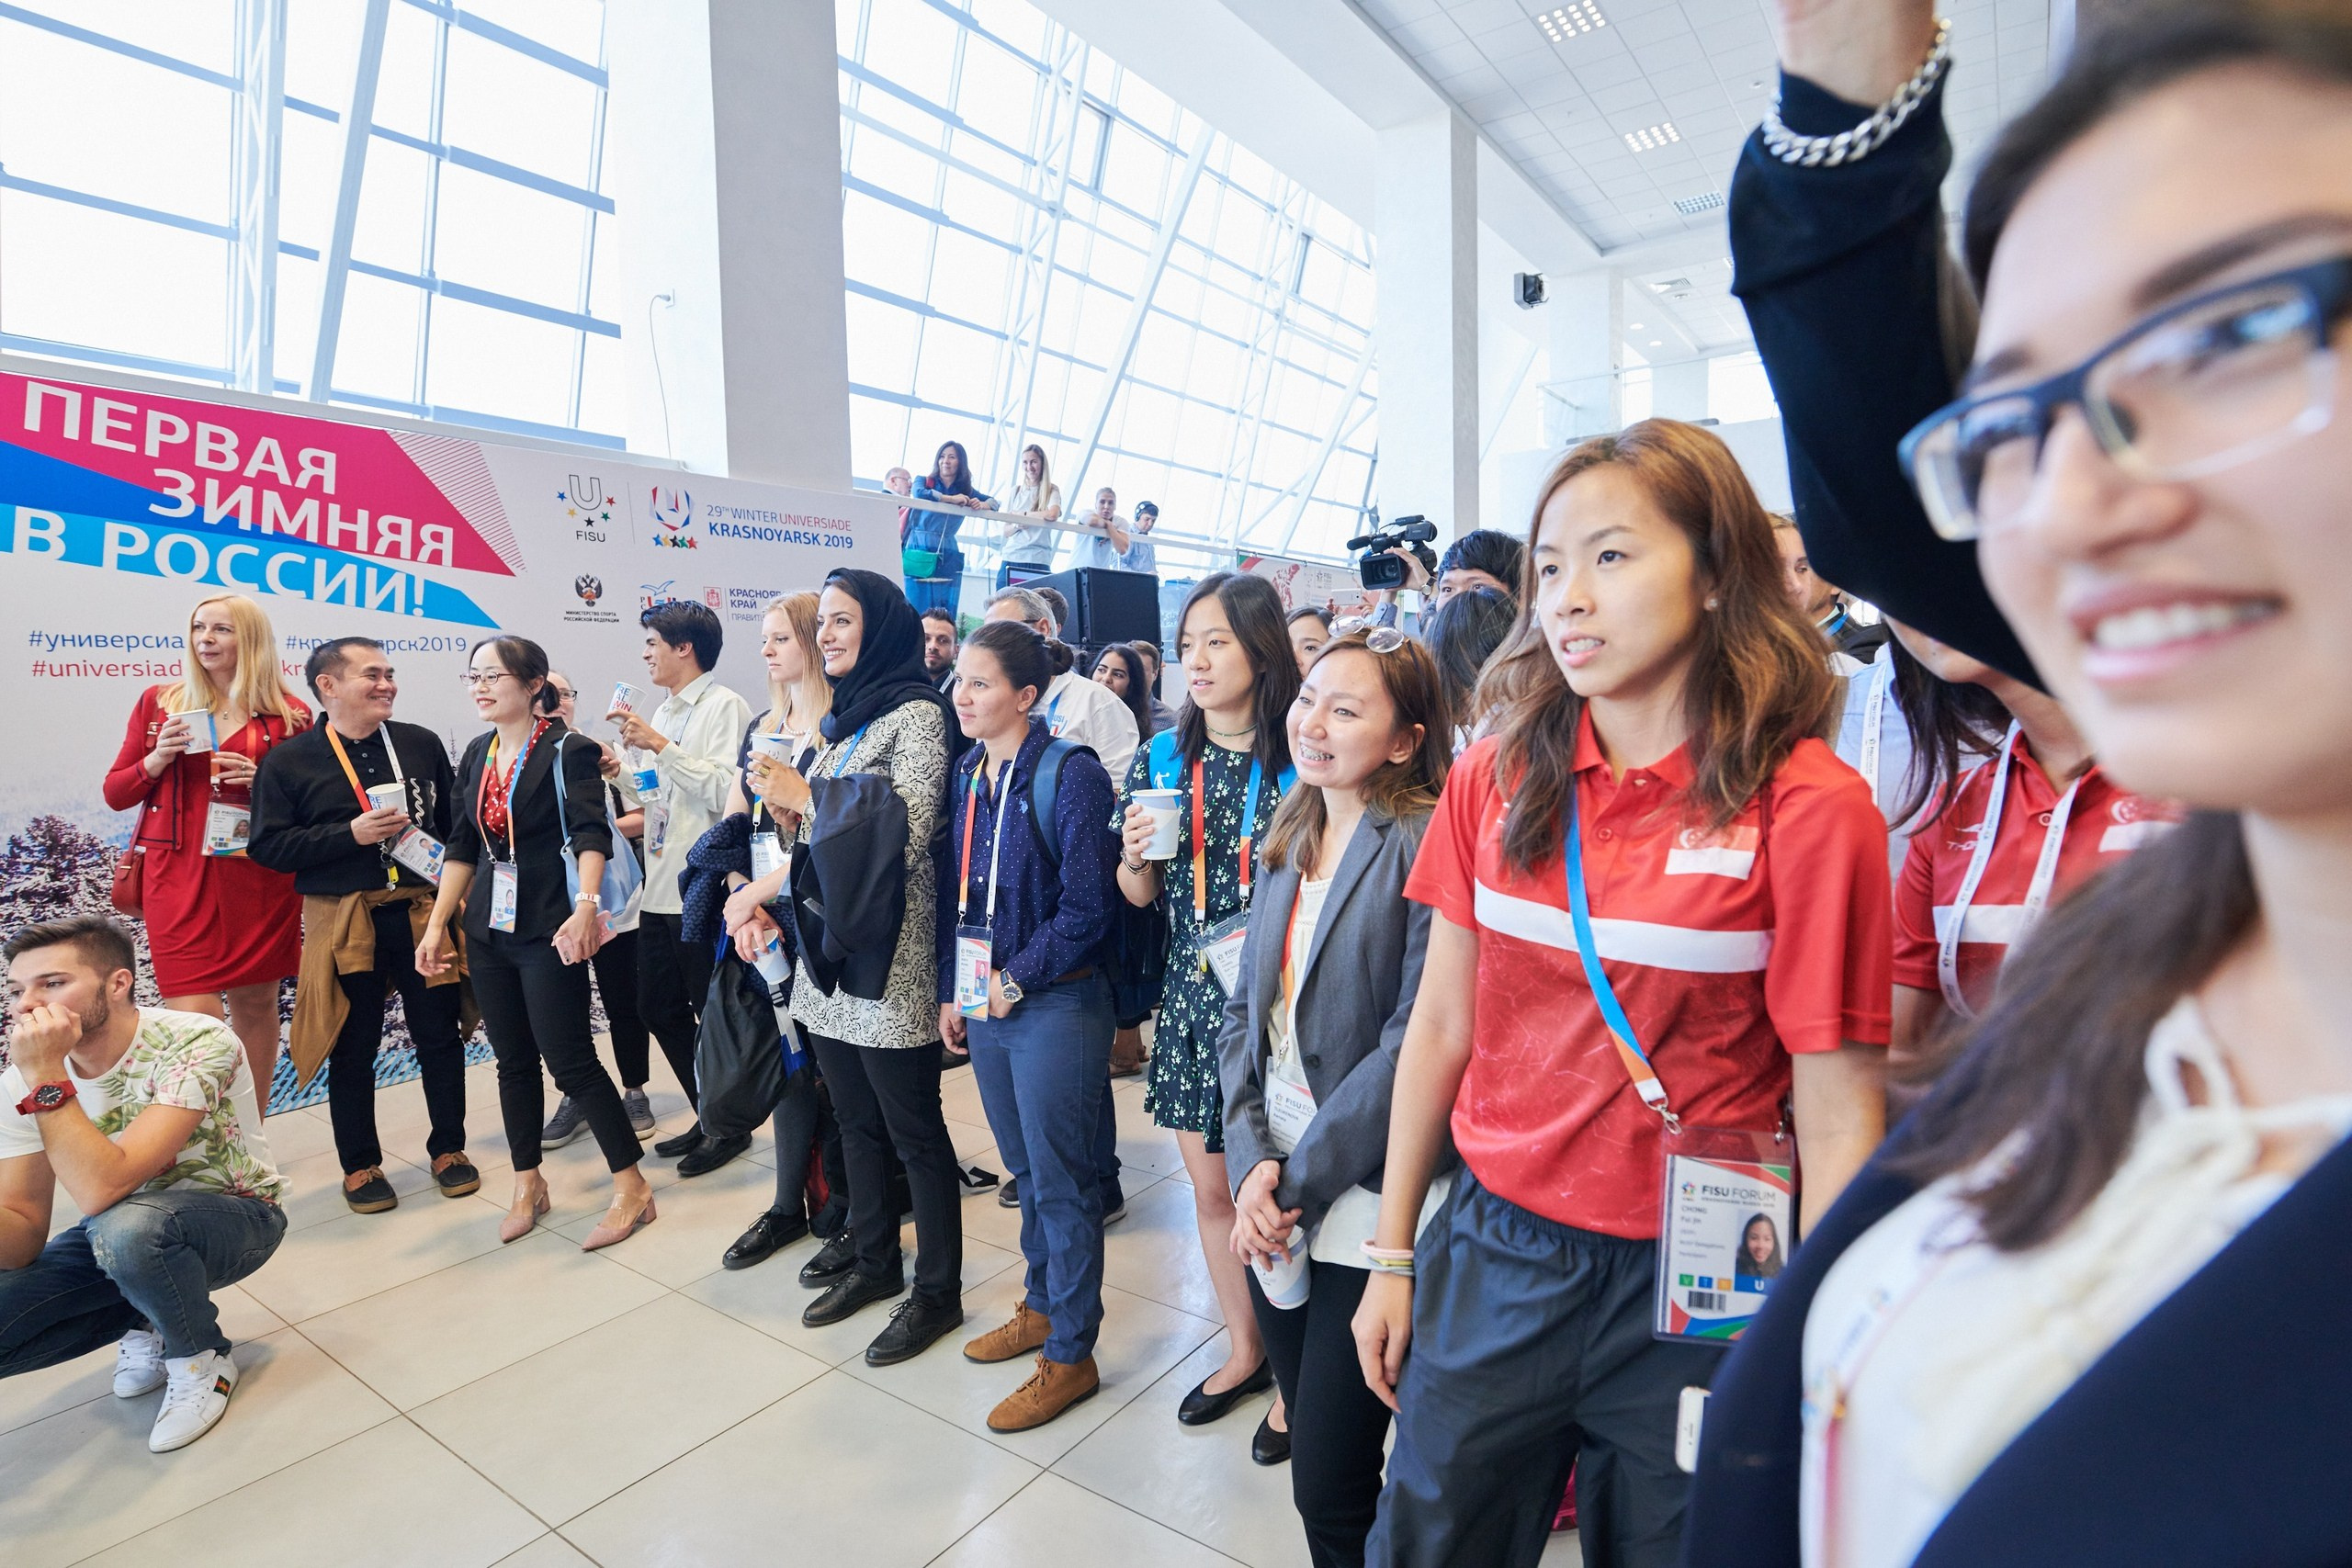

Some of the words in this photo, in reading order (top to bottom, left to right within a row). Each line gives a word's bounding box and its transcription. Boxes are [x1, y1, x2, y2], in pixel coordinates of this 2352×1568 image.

[24, 380, 337, 495] ПЕРВАЯ
[149, 468, 454, 567] ЗИМНЯЯ
[730, 507, 778, 524] WINTER
[779, 513, 852, 532] UNIVERSIADE
[576, 530, 605, 543] FISU
[709, 522, 820, 546] KRASNOYARSK
[824, 534, 854, 549] 2019
[12, 505, 67, 561] В
[102, 521, 426, 617] РОССИИ!
[730, 599, 757, 609] КРАЙ
[28, 630, 186, 653] #универсиа
[286, 635, 467, 655] #крярск2019
[31, 659, 182, 677] #universiad
[1286, 1098, 1301, 1109] FISU
[1702, 1185, 1729, 1197] FISU
[1733, 1187, 1776, 1201] FORUM
